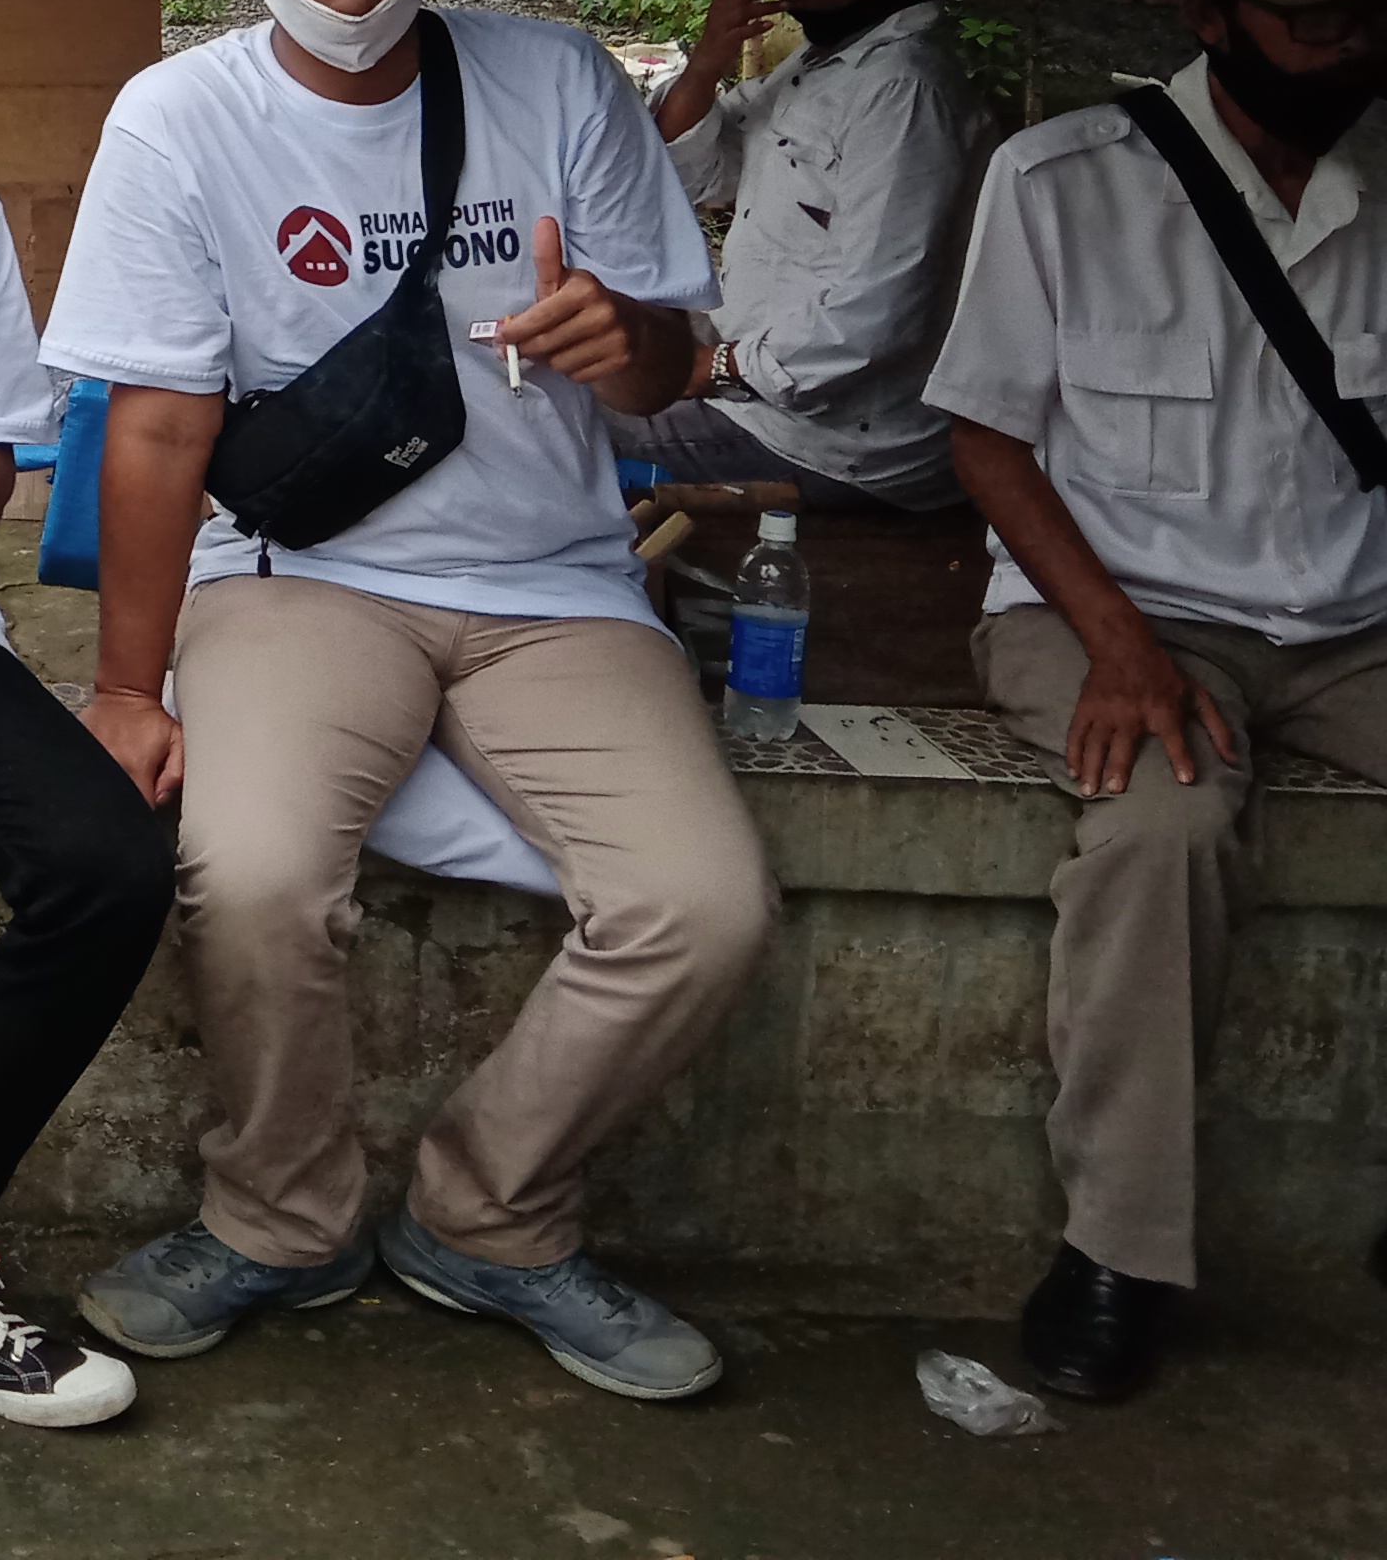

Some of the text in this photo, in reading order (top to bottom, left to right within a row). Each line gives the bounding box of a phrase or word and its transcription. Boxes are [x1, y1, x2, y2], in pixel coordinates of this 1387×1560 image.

[359, 198, 515, 237] RUMA PUTIH
[363, 226, 521, 275] SUONO
